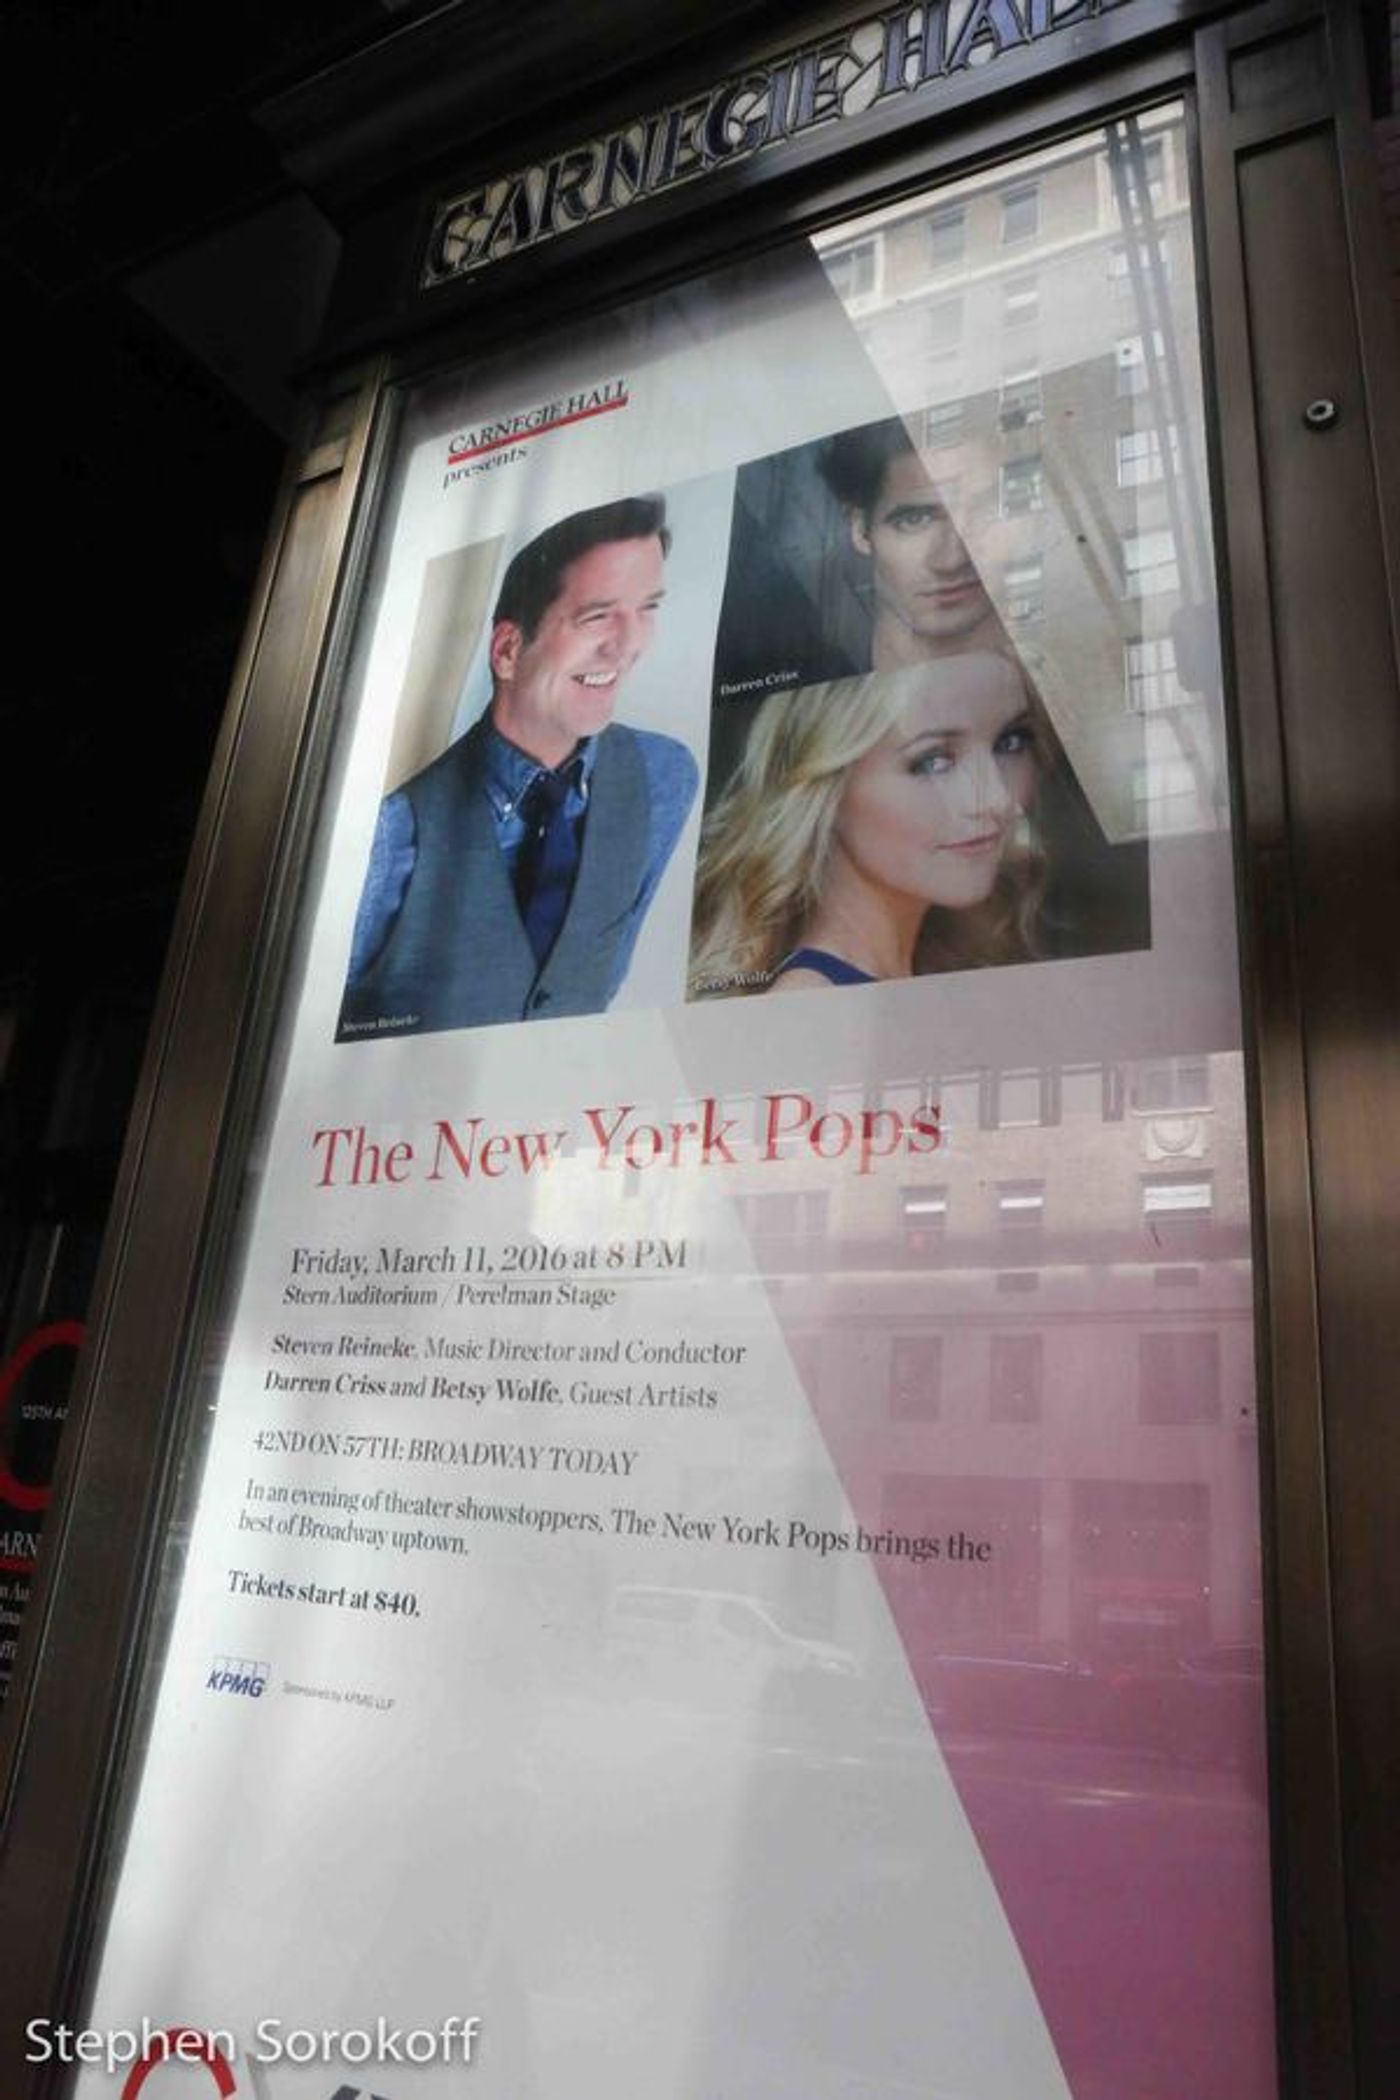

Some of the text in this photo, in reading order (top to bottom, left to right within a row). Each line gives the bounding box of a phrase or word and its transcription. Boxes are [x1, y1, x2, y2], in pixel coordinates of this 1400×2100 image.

[425, 0, 1110, 280] CARNEGIE HAL
[448, 379, 629, 454] CARNEGIE HALL
[443, 447, 528, 490] presents
[312, 1093, 943, 1188] The New York Pops
[291, 1238, 687, 1281] Friday, March 11, 2016 at 8 PM
[282, 1283, 331, 1306] Stern
[331, 1284, 439, 1307] Auditorium
[455, 1282, 552, 1306] Perelman
[556, 1282, 617, 1310] Stage
[271, 1333, 333, 1356] Steven
[423, 1336, 484, 1360] Music
[486, 1337, 577, 1363] Director
[577, 1339, 620, 1363] and
[624, 1339, 748, 1365] Conductor
[263, 1369, 332, 1393] Darren
[334, 1371, 387, 1396] Criss
[388, 1375, 428, 1399] and
[430, 1375, 491, 1406] Betsy
[569, 1379, 633, 1406] Guest
[637, 1382, 719, 1408] Artists
[252, 1429, 639, 1477] 42ND ON 57TH: BROADWAY TODAY
[238, 1507, 469, 1556] best of Broadway uptown.
[246, 1477, 992, 1564] In an evening of theater showstoppers, The New York Pops brings the
[227, 1568, 421, 1619] Tickets start at $40.
[205, 1668, 267, 1699] KPMG
